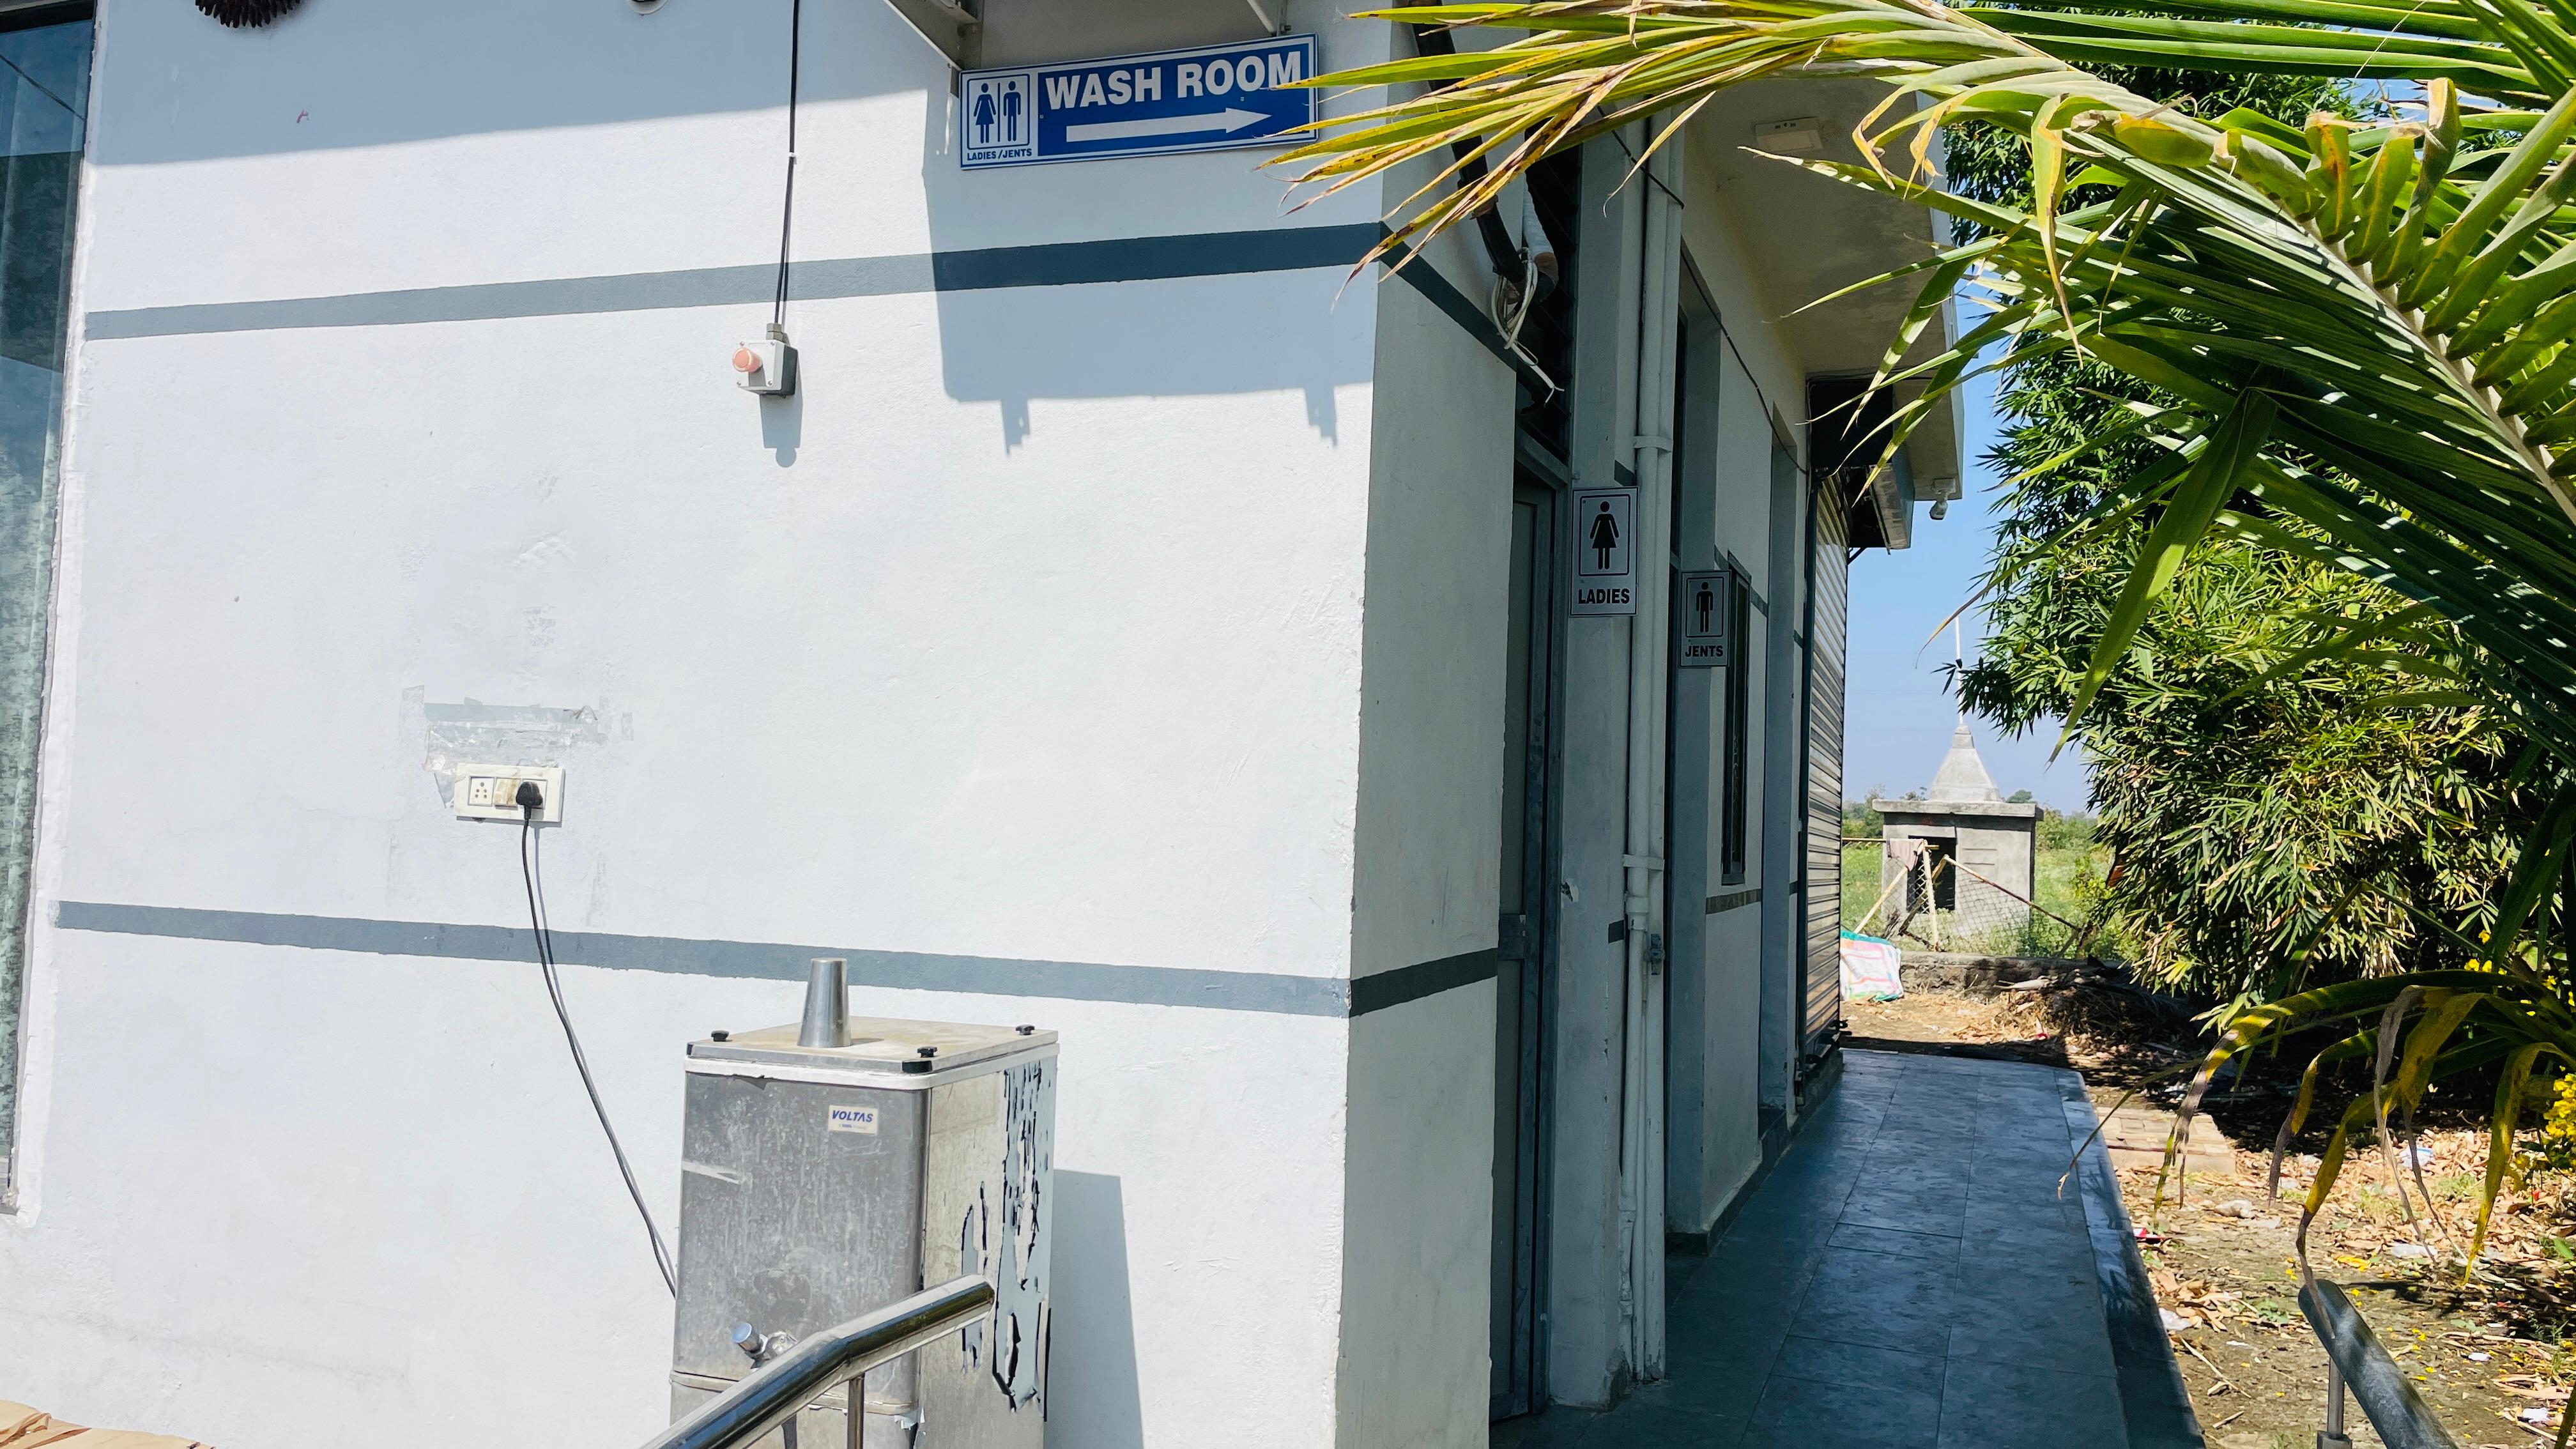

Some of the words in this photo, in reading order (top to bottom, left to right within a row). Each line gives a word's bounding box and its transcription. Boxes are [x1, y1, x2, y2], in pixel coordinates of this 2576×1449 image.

[1045, 66, 1161, 110] WASH
[1177, 50, 1301, 98] ROOM
[1578, 588, 1630, 604] LADIES
[1685, 645, 1723, 657] JENTS
[832, 1110, 873, 1123] VOLTAS
